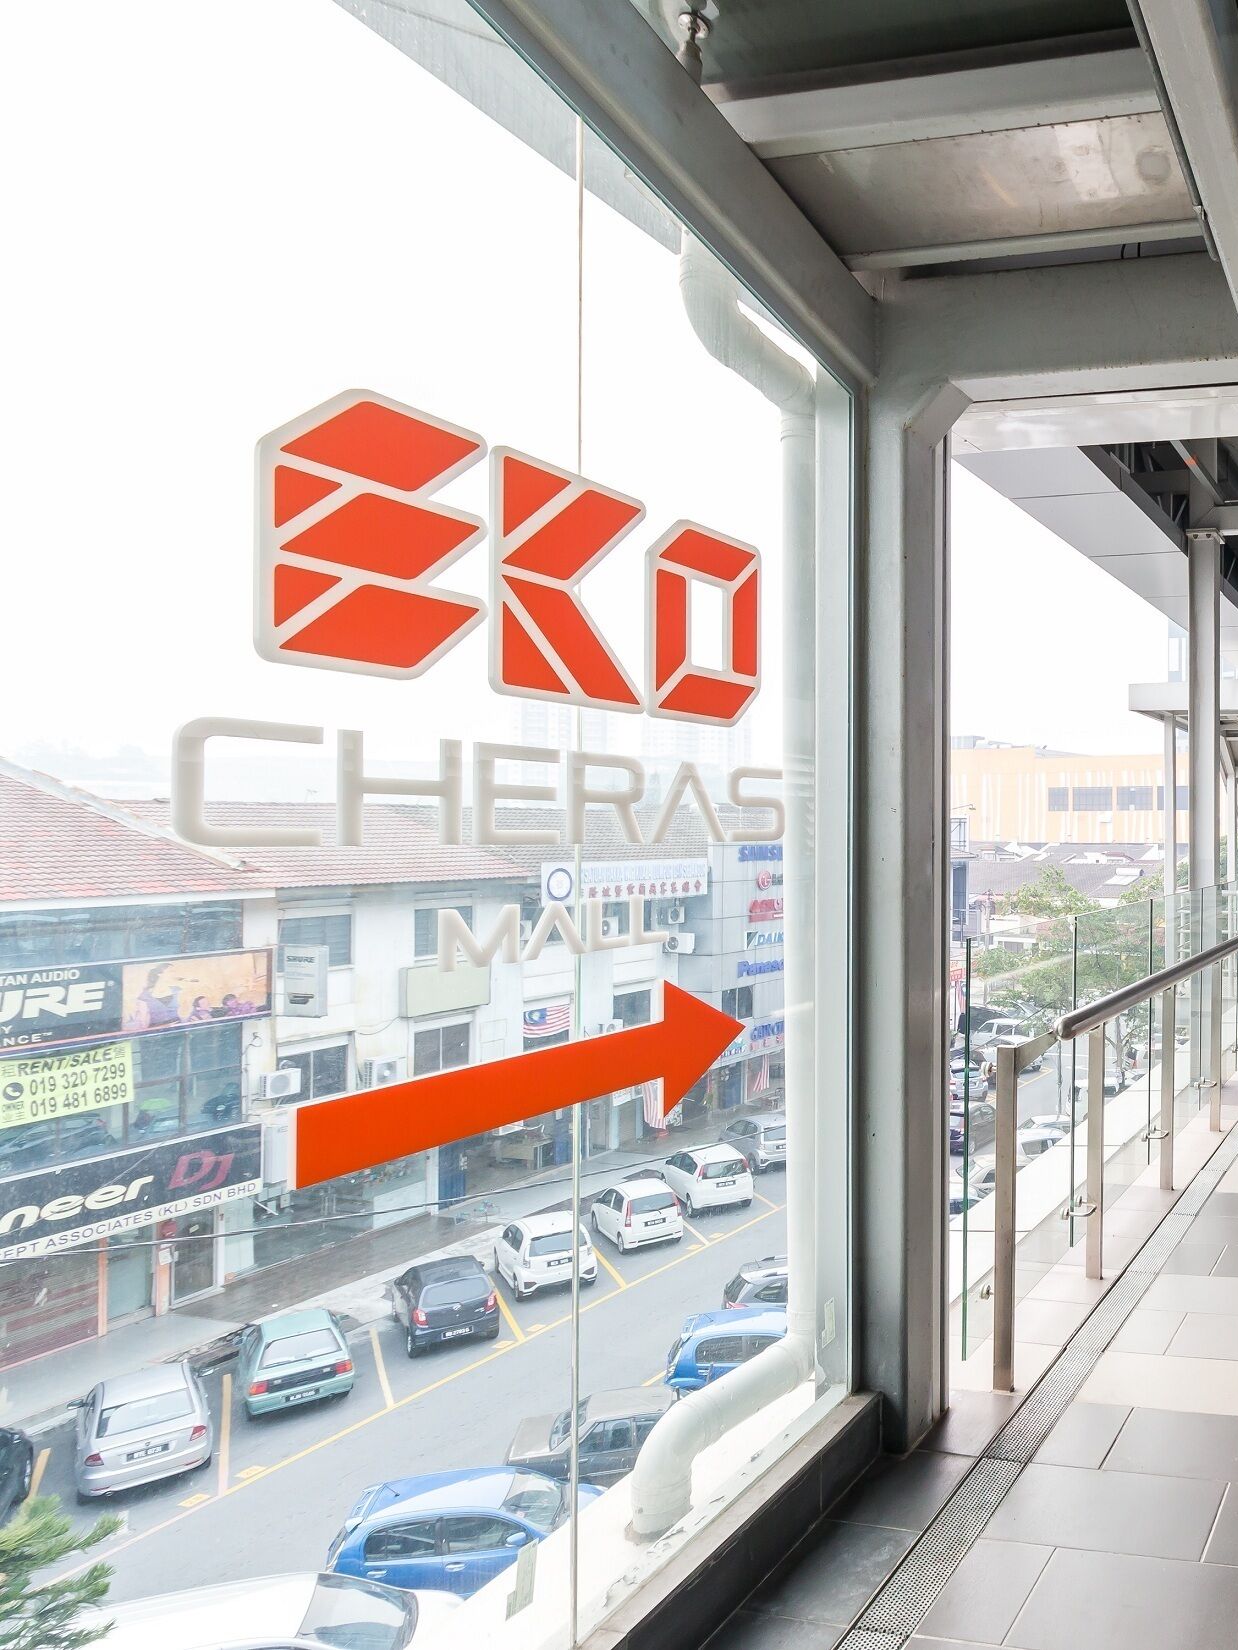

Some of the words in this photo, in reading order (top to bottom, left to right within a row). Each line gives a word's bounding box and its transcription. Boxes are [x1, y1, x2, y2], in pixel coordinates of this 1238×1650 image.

[254, 388, 762, 728] EKO
[172, 716, 786, 847] CHERAS
[438, 896, 670, 973] MALL
[30, 969, 80, 984] AUDIO
[17, 1047, 113, 1077] RENT/SALE
[29, 1076, 57, 1096] 019
[62, 1070, 88, 1090] 320
[93, 1062, 126, 1083] 7299
[30, 1096, 57, 1117] 019
[63, 1090, 88, 1110] 481
[94, 1082, 127, 1104] 6899
[168, 1150, 235, 1192] DJ
[44, 1211, 153, 1250] ASSOCIATES
[158, 1201, 189, 1218] (KL)
[192, 1190, 223, 1208] SDN
[227, 1183, 257, 1198] BHD
